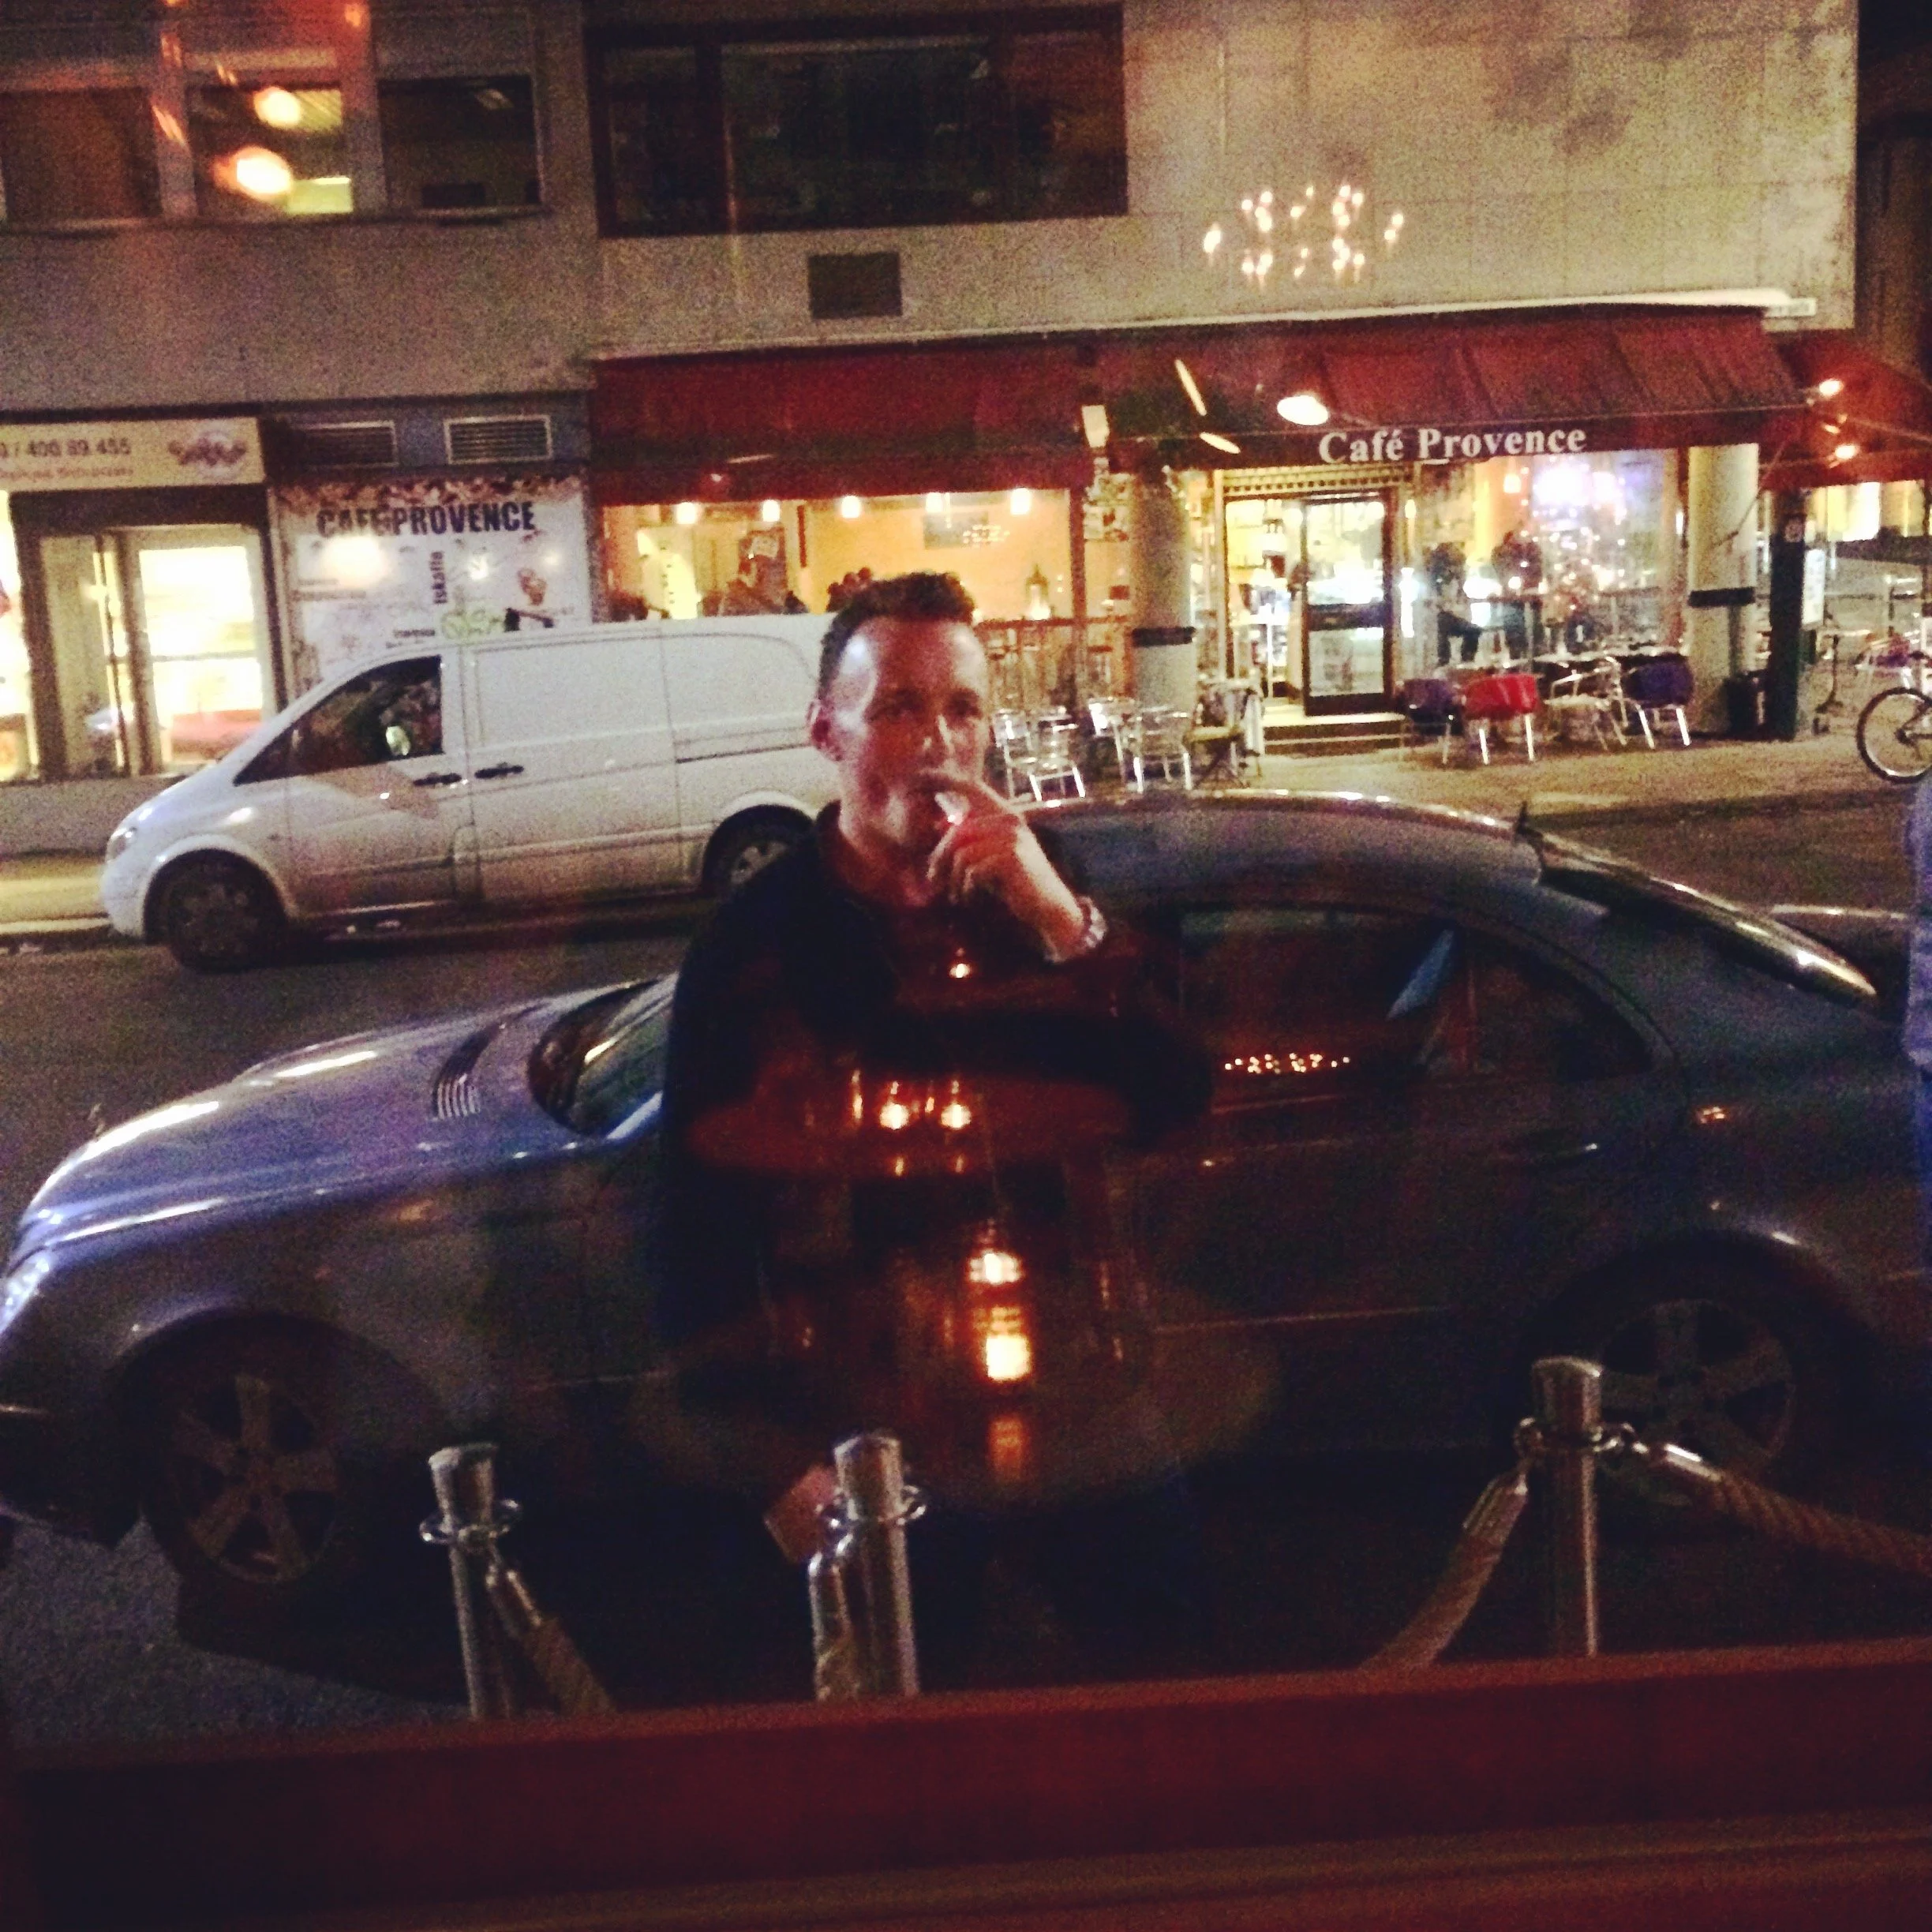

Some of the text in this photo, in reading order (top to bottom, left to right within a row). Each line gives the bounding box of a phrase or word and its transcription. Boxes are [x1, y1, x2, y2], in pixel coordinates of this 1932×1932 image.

[1319, 429, 1587, 463] Café Provence
[393, 500, 535, 535] PROVENCE
